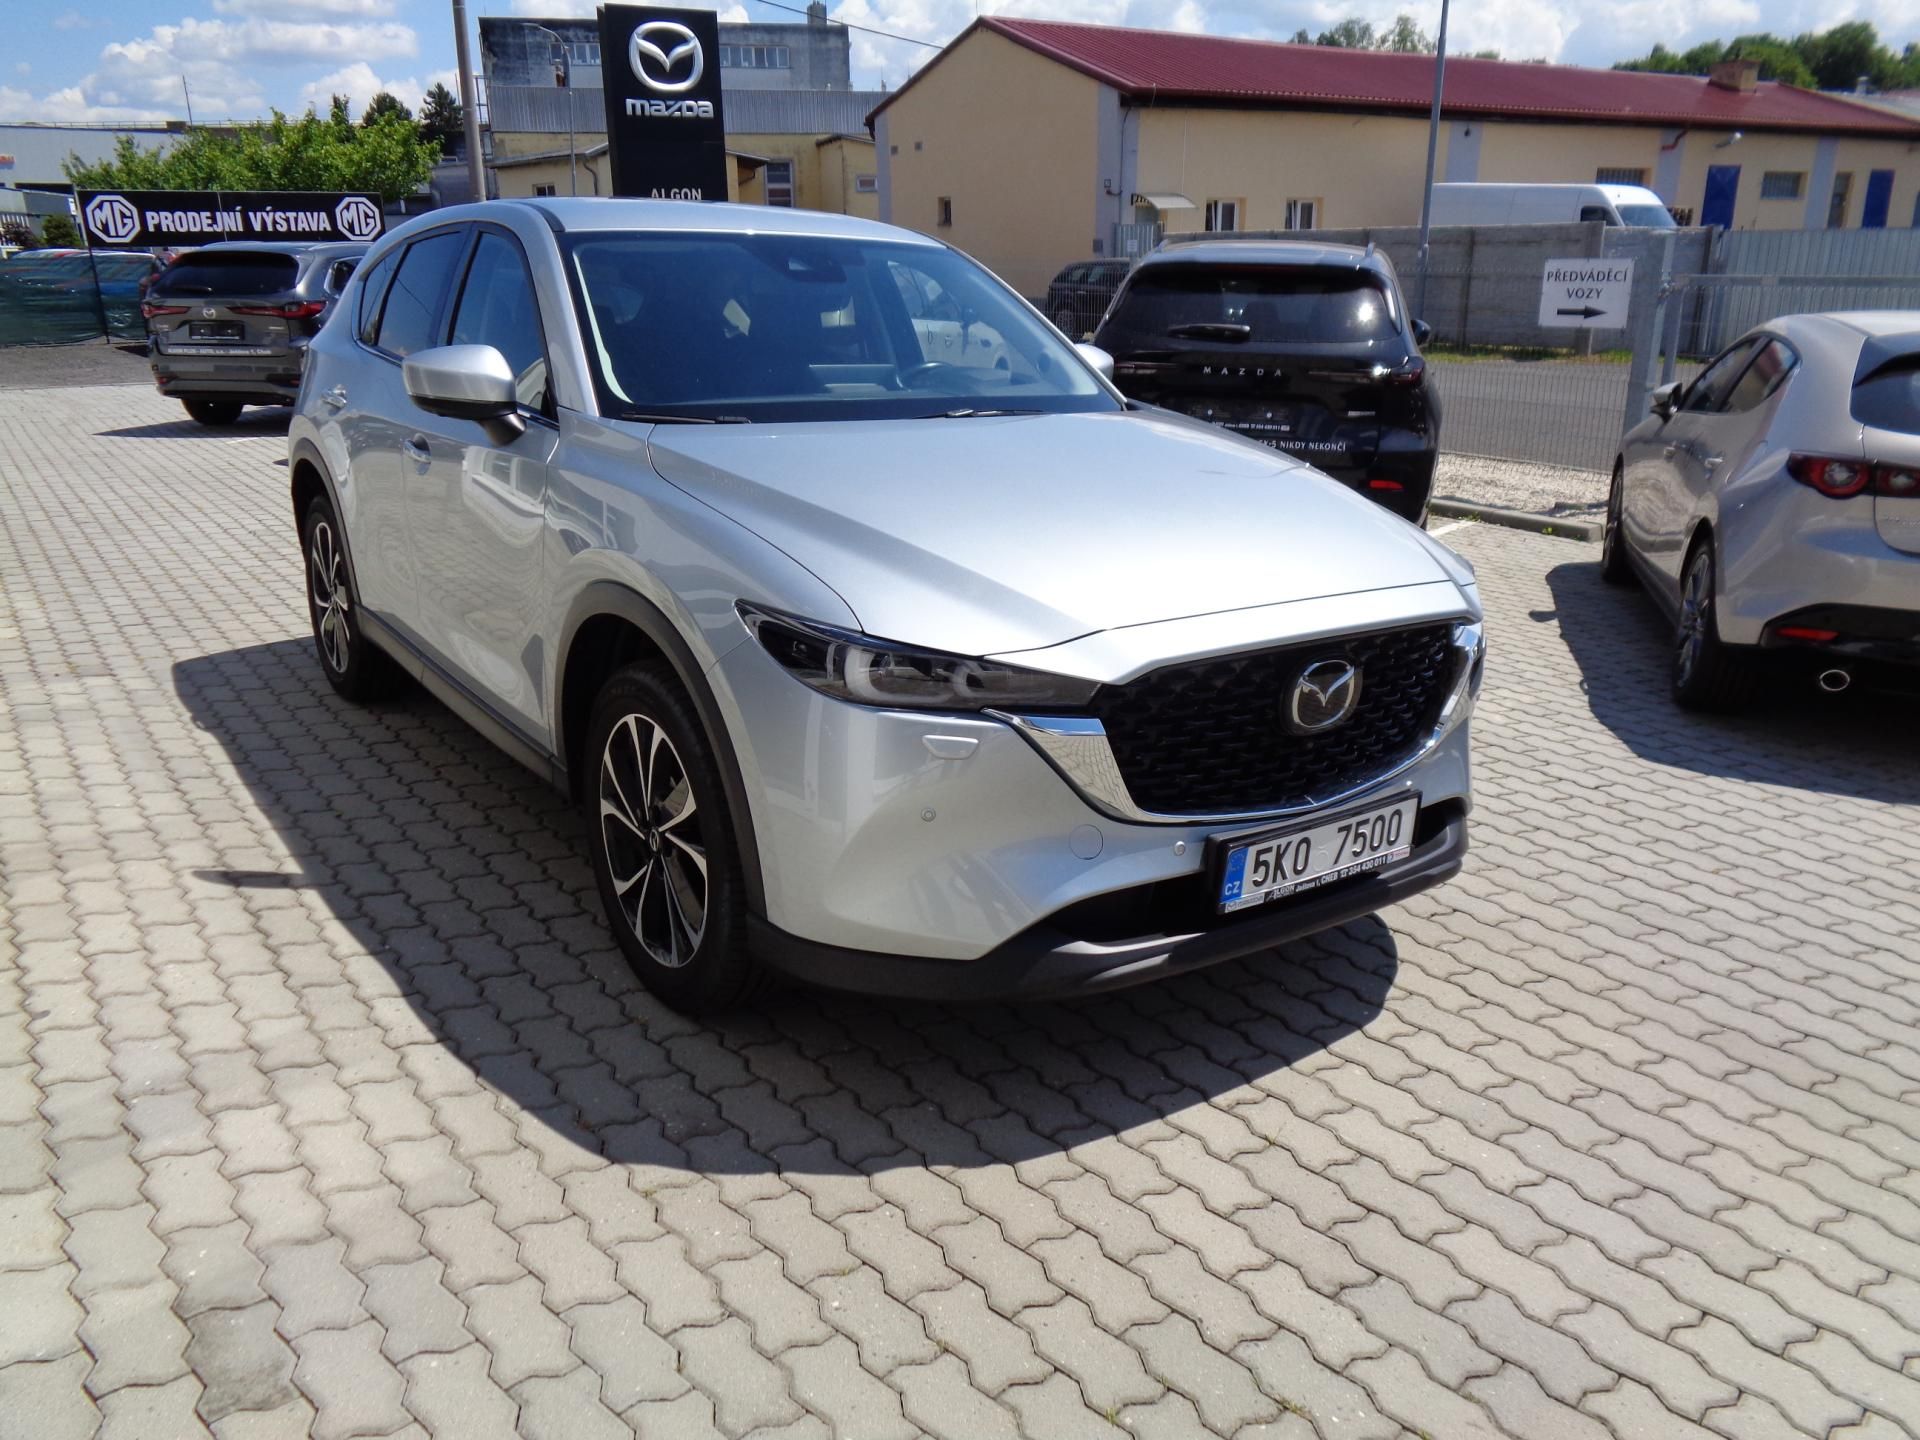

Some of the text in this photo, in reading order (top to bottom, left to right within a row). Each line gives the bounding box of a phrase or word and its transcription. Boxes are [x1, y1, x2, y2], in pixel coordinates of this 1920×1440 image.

[93, 200, 376, 238] MG PRODEJNÍ VÝSTAVA MG
[1546, 267, 1628, 282] PŘEDVÁDĚCÍ
[1566, 287, 1604, 299] VOZY
[1203, 366, 1282, 377] MAZDA
[1280, 440, 1305, 450] NIKDY
[1333, 808, 1403, 866] 7500
[1224, 883, 1240, 896] CZ
